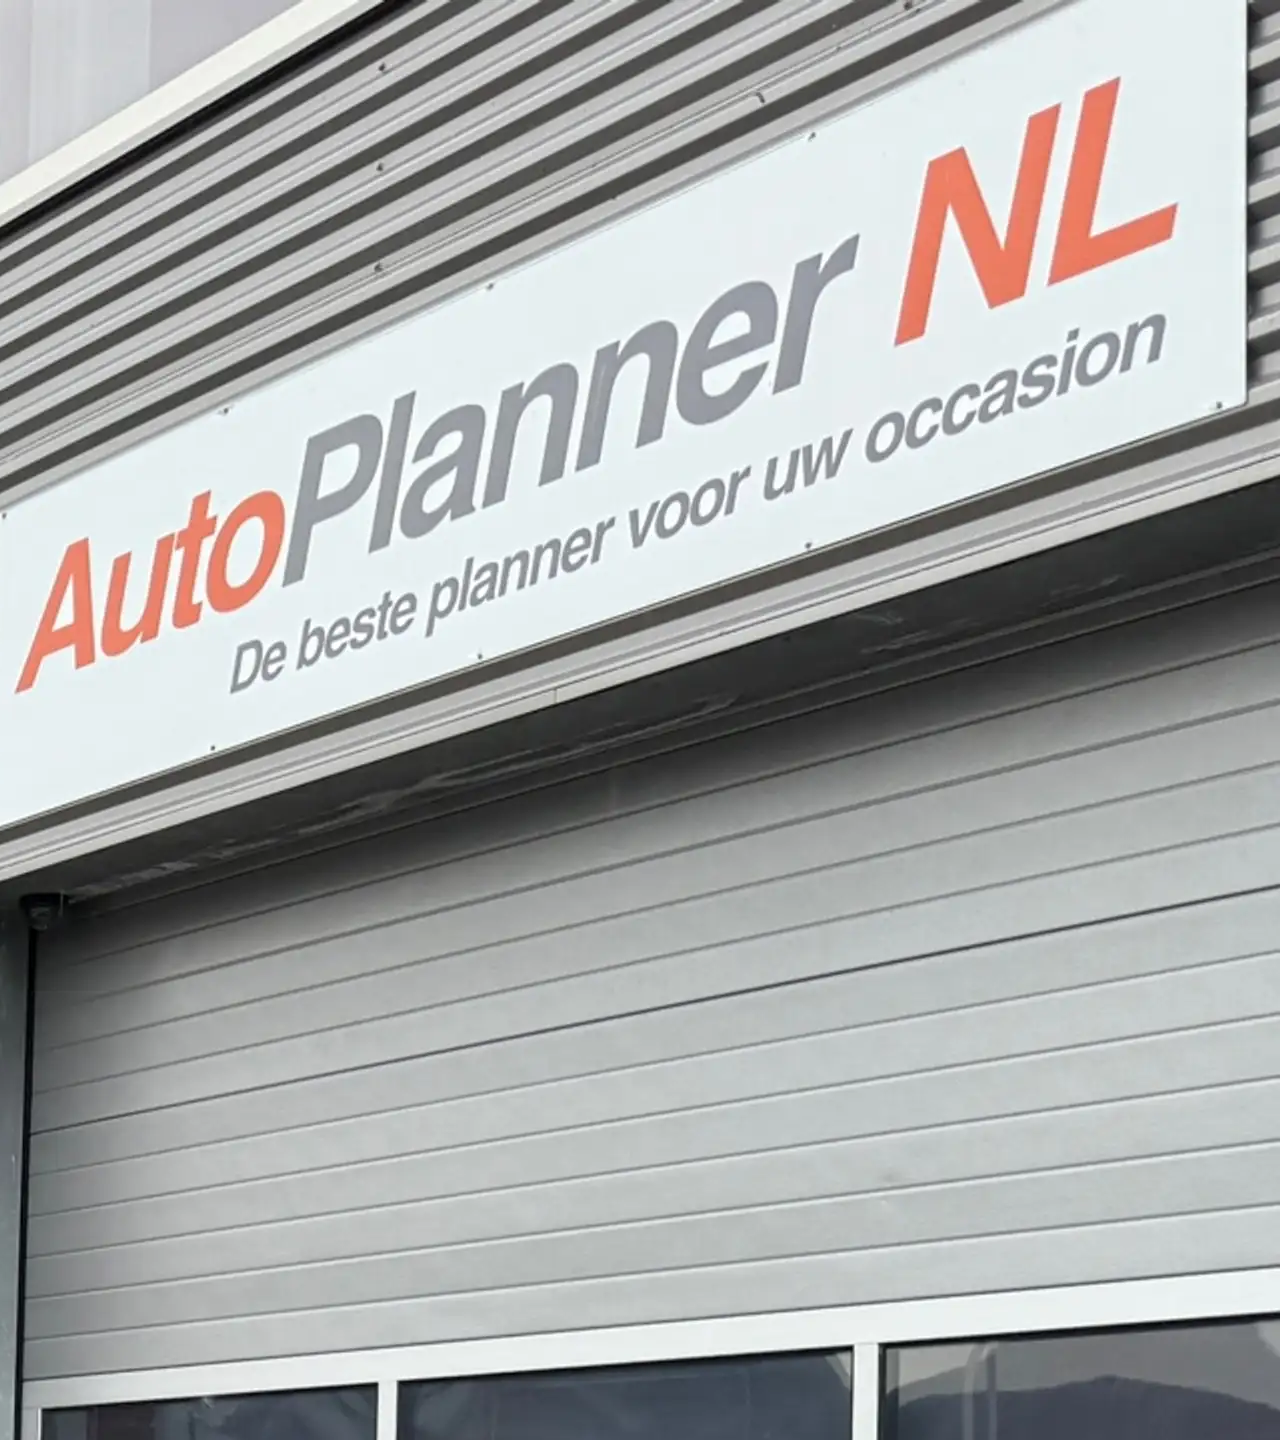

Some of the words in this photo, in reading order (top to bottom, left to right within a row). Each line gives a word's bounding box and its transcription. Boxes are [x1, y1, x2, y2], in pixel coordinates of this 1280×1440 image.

[16, 234, 859, 692] AutoPlanner
[895, 77, 1177, 346] NL
[231, 640, 286, 693] De
[297, 590, 416, 669] beste
[424, 510, 615, 637] planner
[630, 466, 751, 547] voor
[765, 426, 853, 500] uw
[866, 314, 1165, 464] occasion
